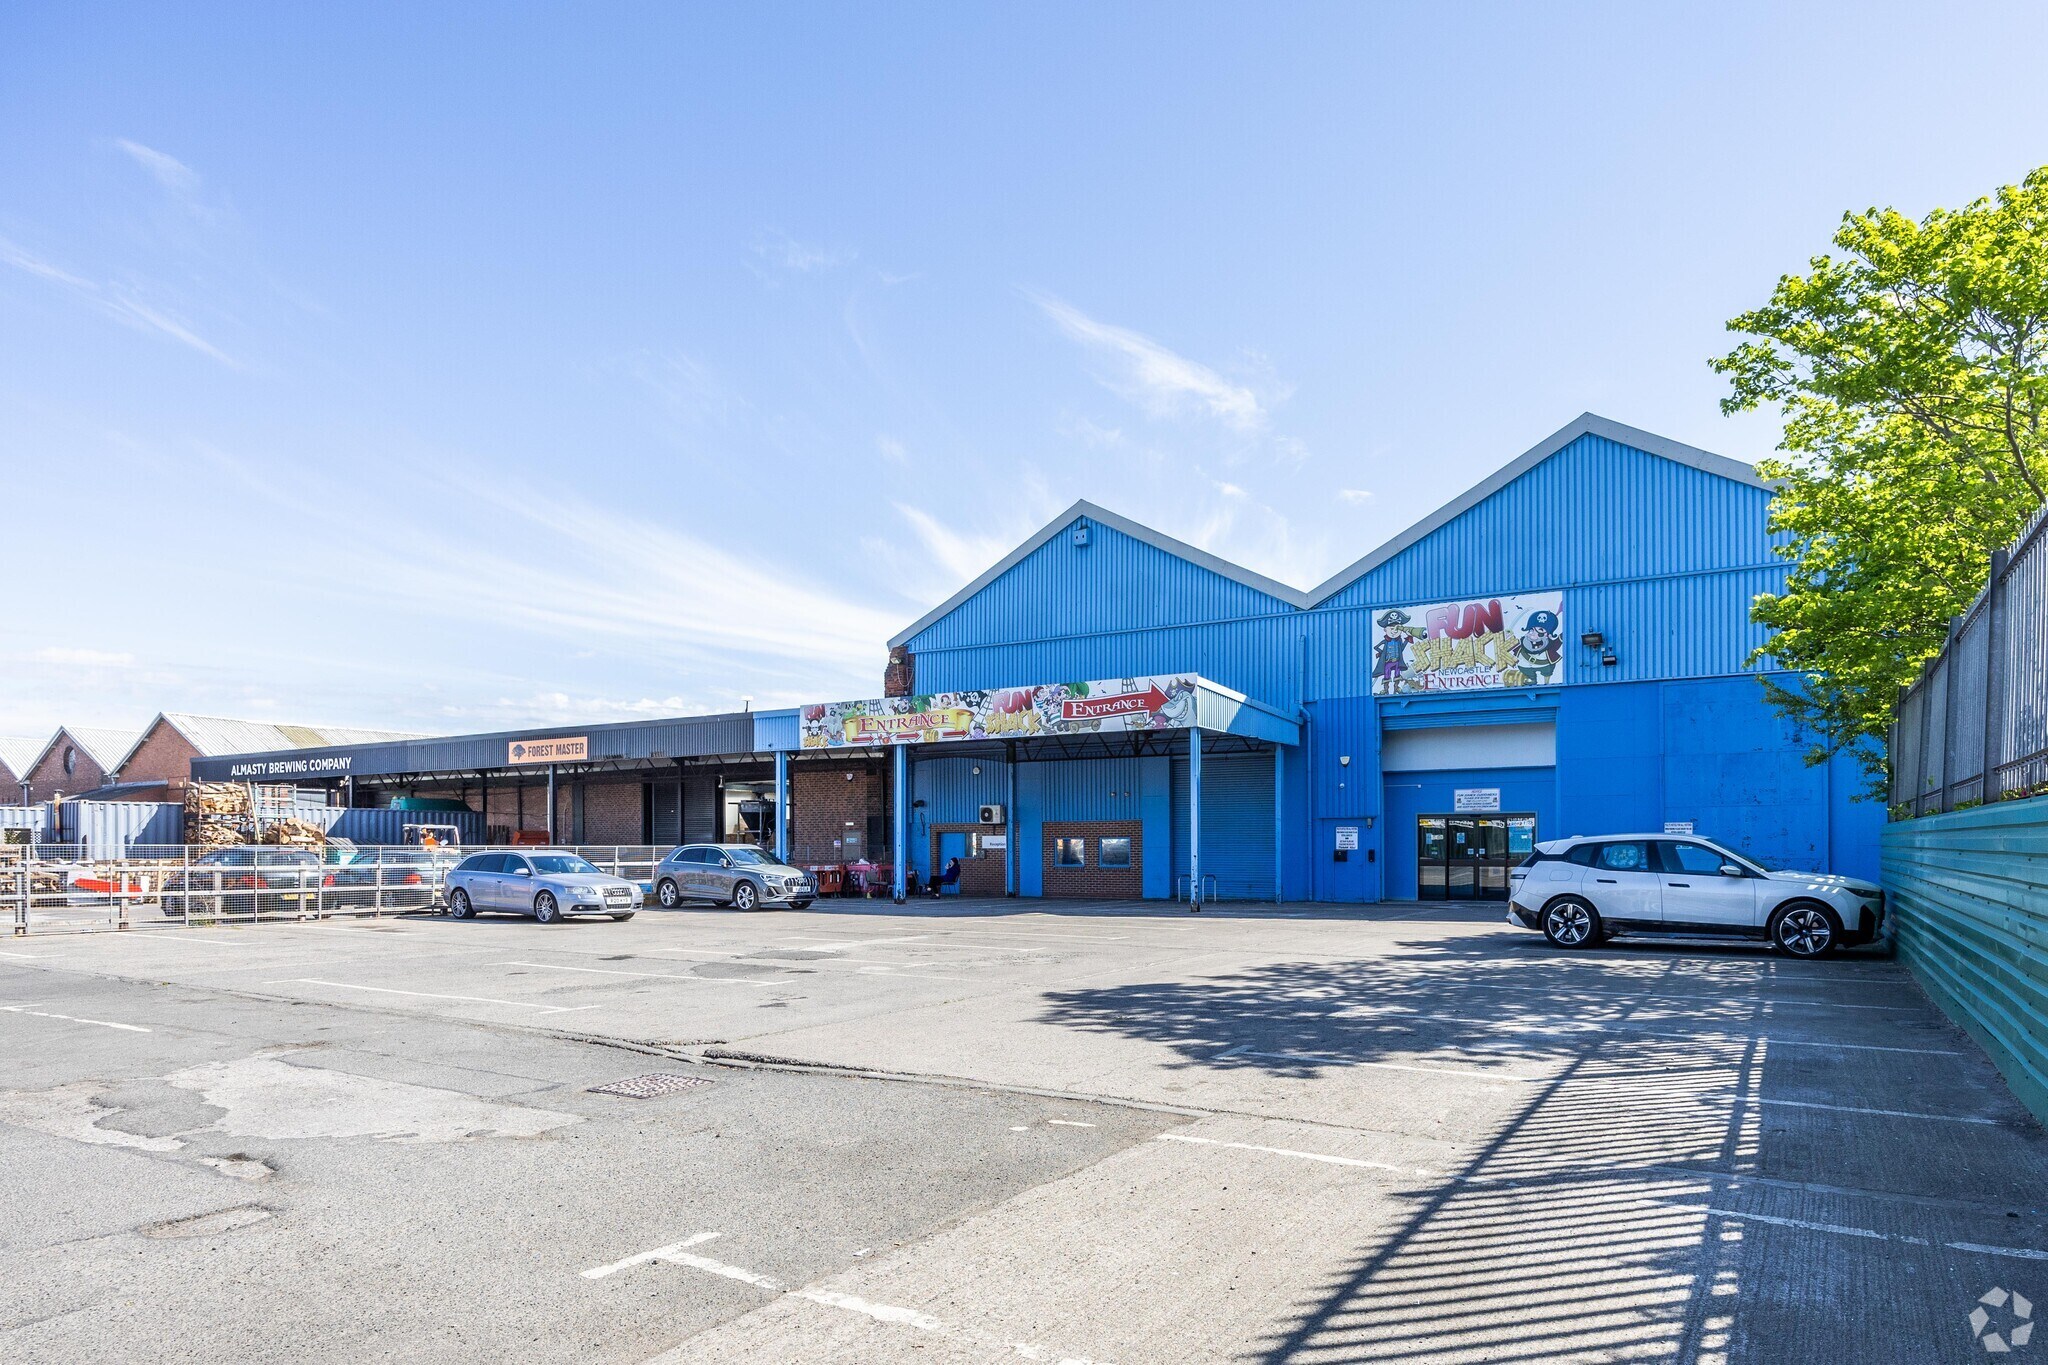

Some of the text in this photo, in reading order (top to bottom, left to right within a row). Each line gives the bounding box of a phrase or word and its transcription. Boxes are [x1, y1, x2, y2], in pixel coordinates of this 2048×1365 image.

[1426, 598, 1504, 641] FUN
[1410, 630, 1521, 673] SHACK
[1424, 672, 1501, 690] ENTRANCE
[1438, 666, 1490, 677] NEWCASTLE
[993, 688, 1034, 714] FUN
[1071, 698, 1147, 717] ENTRANCE
[860, 713, 953, 732] ENTRANCE
[985, 709, 1042, 736] SHACK
[528, 742, 585, 758] FOREST MASTER
[231, 757, 352, 776] ALMASTY BREWING COMPANY
